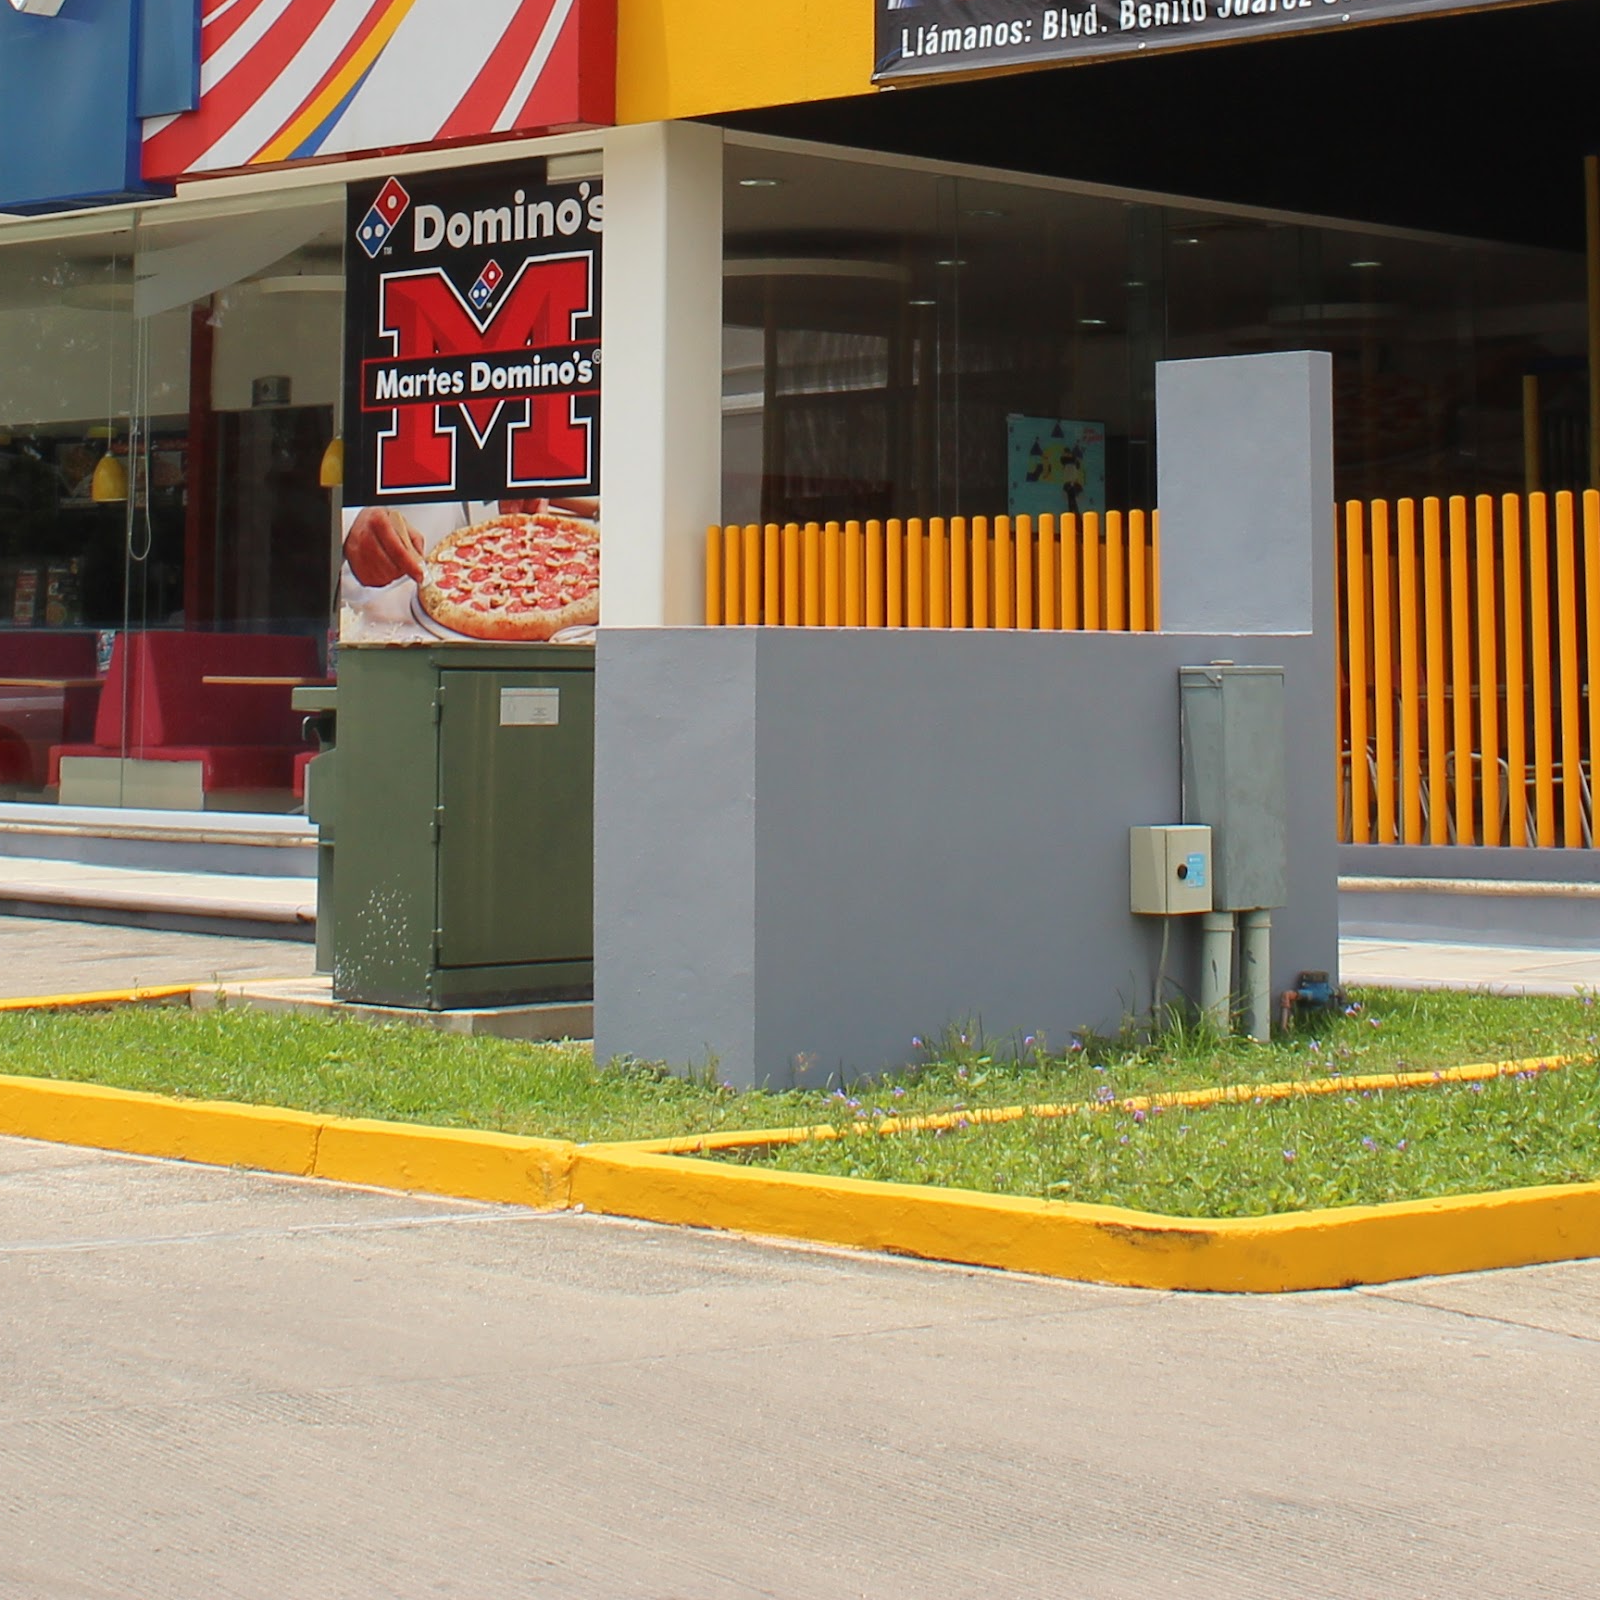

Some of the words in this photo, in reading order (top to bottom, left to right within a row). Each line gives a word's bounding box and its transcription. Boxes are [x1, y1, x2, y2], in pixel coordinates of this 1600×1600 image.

[901, 18, 1033, 59] Llámanos:
[1042, 4, 1108, 41] Blvd.
[414, 181, 603, 253] Domino's
[376, 364, 464, 400] Martes
[470, 350, 593, 392] Domino's
